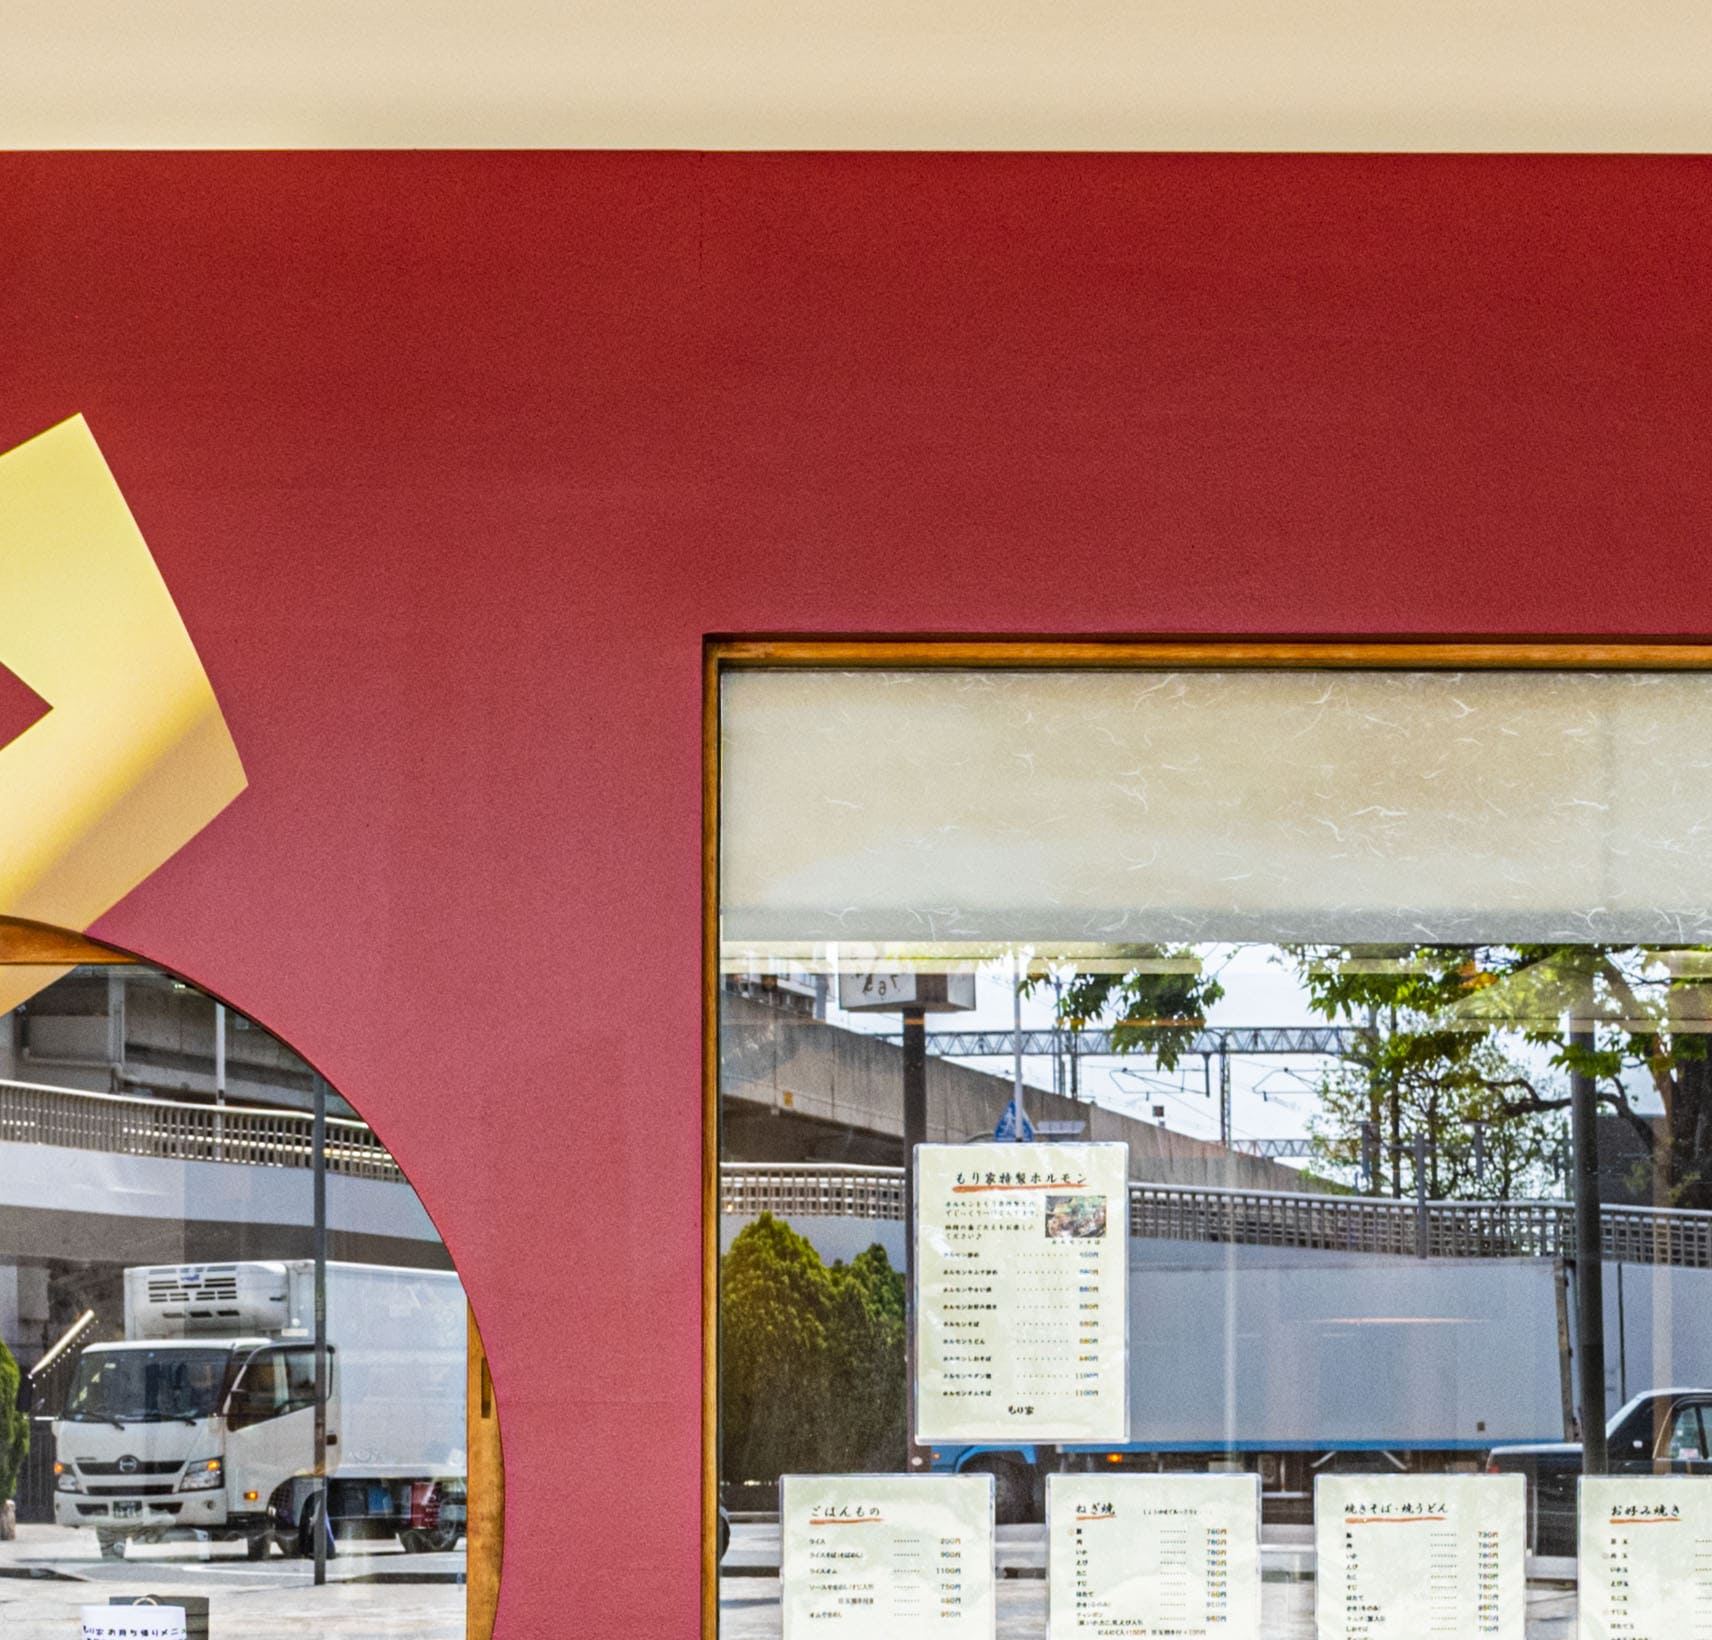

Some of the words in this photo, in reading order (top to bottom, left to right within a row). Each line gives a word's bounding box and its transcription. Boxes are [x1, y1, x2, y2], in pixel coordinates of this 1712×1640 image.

[956, 1173, 1088, 1184] もり家特製ホルモン
[1007, 1405, 1036, 1416] もり家
[810, 1506, 881, 1517] ごはんもの
[1076, 1503, 1116, 1514] ねぎ焼
[1345, 1503, 1448, 1514] 焼きそば・焼うどん
[1611, 1505, 1681, 1516] お好み焼き
[935, 1567, 962, 1575] 1100円
